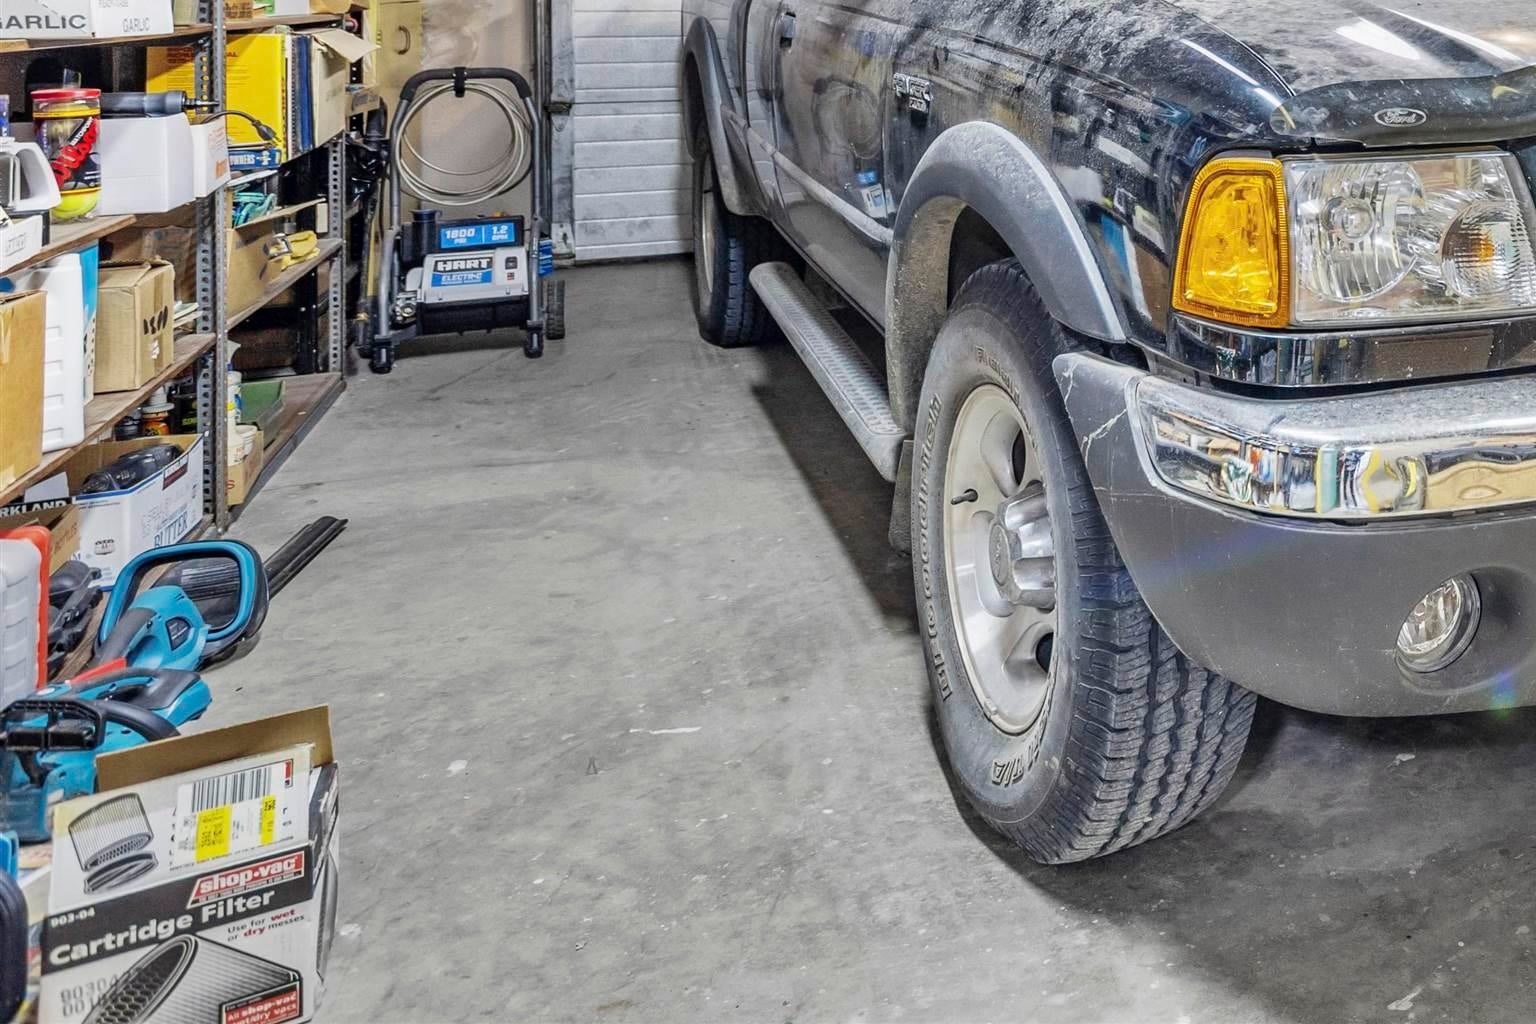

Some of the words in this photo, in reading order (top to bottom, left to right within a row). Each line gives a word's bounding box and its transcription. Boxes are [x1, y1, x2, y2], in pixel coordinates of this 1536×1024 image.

[122, 17, 151, 34] GARLIC
[1384, 110, 1417, 125] Ford
[445, 228, 476, 240] 1800
[491, 225, 509, 235] 1.2
[436, 258, 491, 272] HART
[51, 906, 96, 927] 903-04
[227, 924, 247, 934] Use
[250, 918, 265, 928] for
[271, 908, 296, 921] wet
[244, 926, 266, 937] dry
[268, 914, 305, 930] messes
[50, 912, 193, 966] Cartridge
[202, 890, 275, 923] Filter
